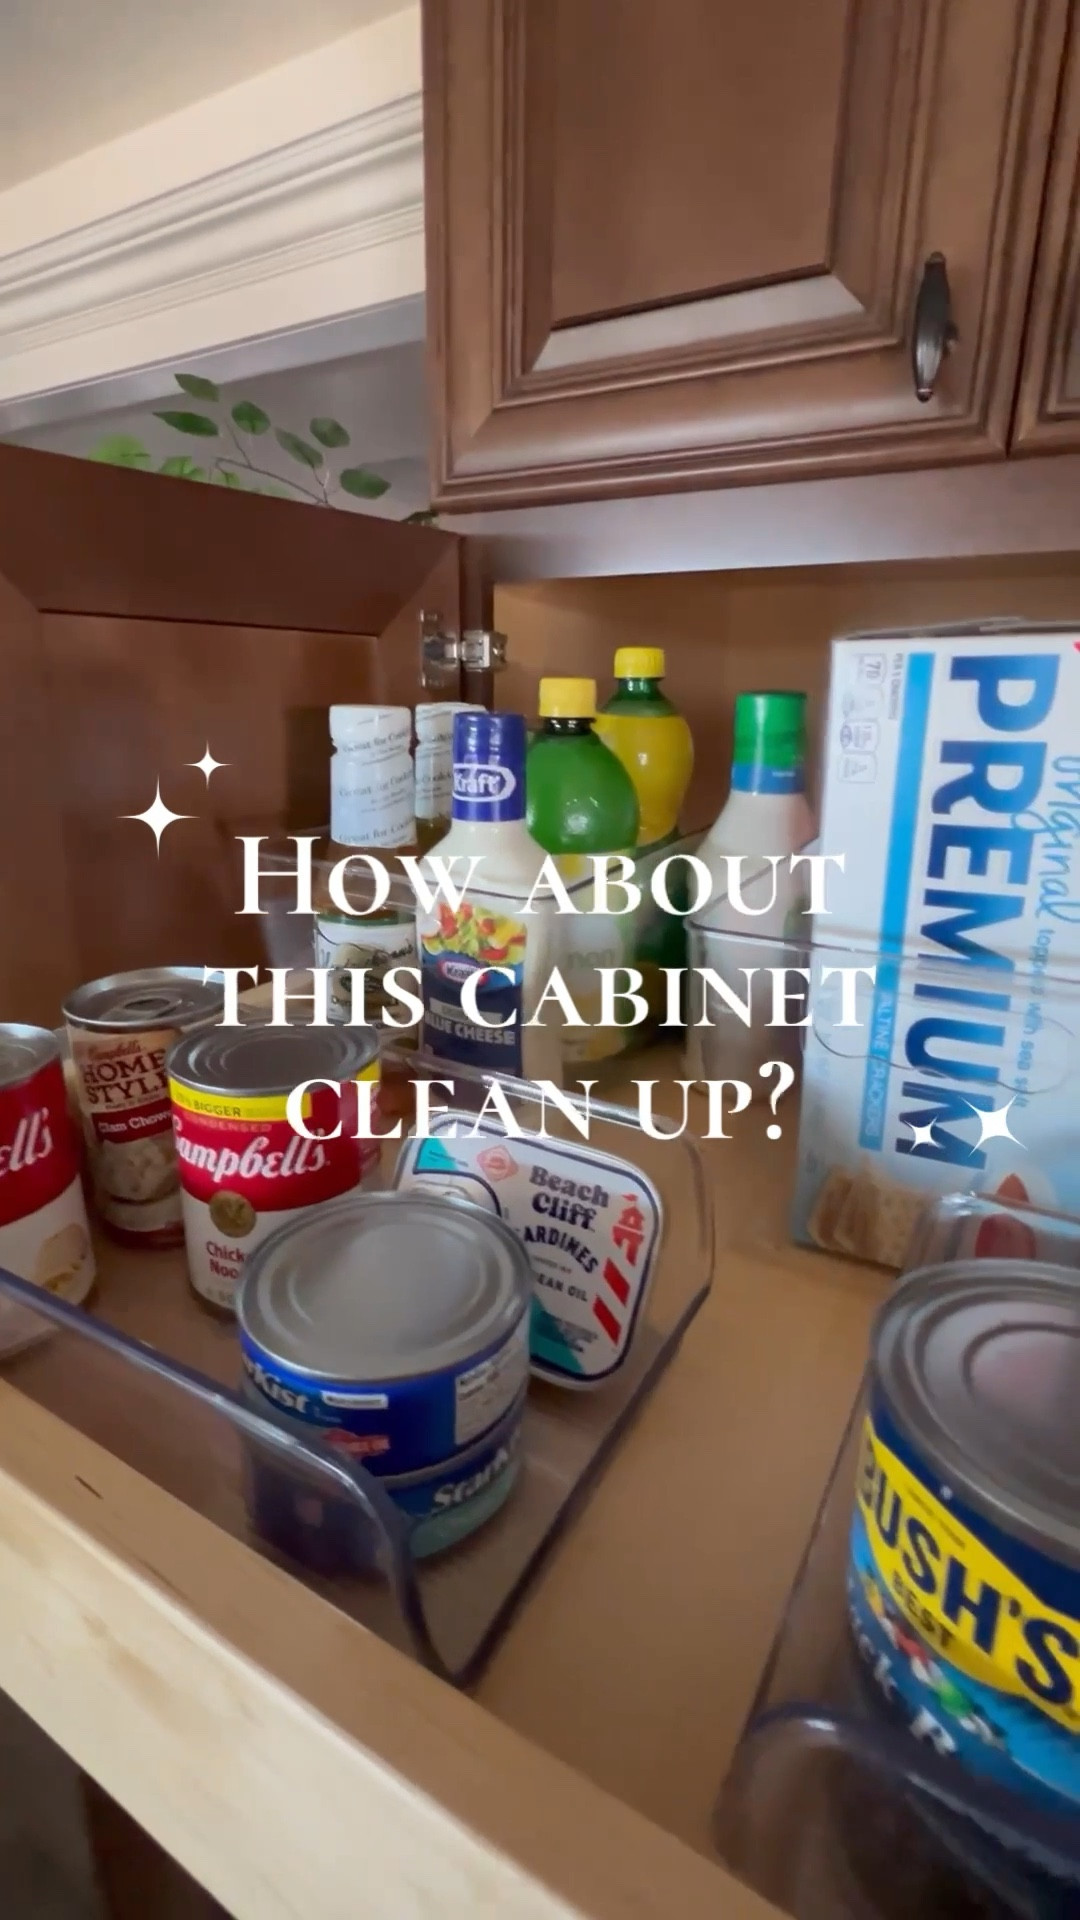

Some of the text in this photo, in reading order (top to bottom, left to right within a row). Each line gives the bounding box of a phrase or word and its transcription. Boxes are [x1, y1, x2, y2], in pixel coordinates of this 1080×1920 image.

[453, 767, 501, 794] Kraft
[896, 652, 1061, 1171] PREMIUM
[454, 1023, 516, 1047] CHEESE
[84, 1050, 167, 1086] HOME
[1017, 1040, 1036, 1071] sea
[128, 1111, 171, 1130] Chow
[193, 1099, 242, 1118] BIGGER
[529, 1164, 610, 1209] Beach
[532, 1192, 598, 1230] Cliff
[206, 1240, 246, 1264] Chick
[523, 1224, 599, 1274] ARDINES
[209, 1258, 240, 1280] Noo
[567, 1284, 588, 1302] OIL
[242, 1352, 309, 1415] rKist
[893, 1568, 956, 1649] BEST
